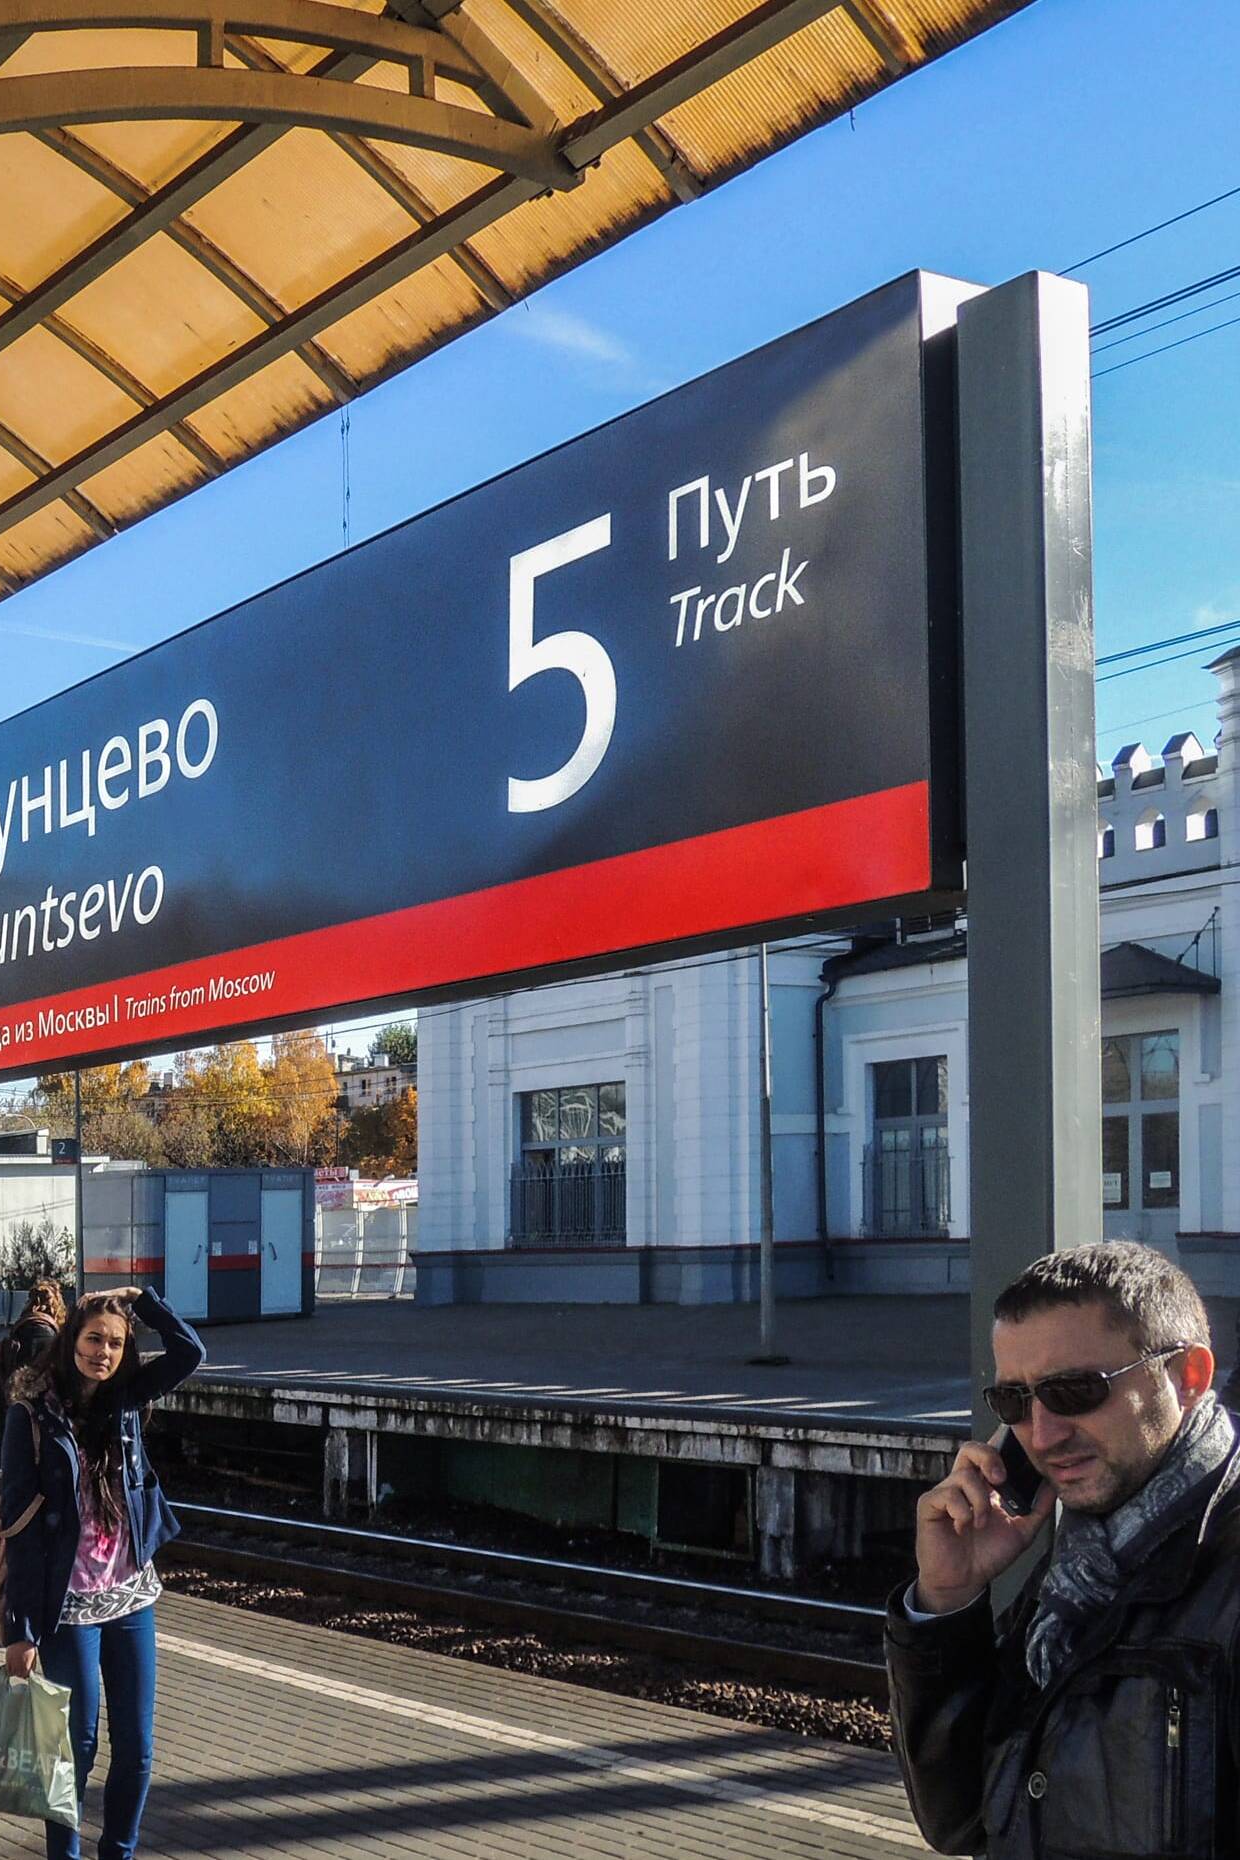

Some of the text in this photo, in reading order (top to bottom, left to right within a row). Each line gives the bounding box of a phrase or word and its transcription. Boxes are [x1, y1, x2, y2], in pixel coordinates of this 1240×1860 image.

[668, 451, 837, 564] Путь
[669, 547, 809, 648] Track
[507, 511, 618, 814] 5
[14, 1020, 34, 1043] из
[37, 1003, 110, 1039] Москвы
[125, 995, 167, 1020] Trains
[168, 987, 205, 1012] from
[208, 970, 276, 1002] Moscow
[58, 1141, 66, 1155] 2
